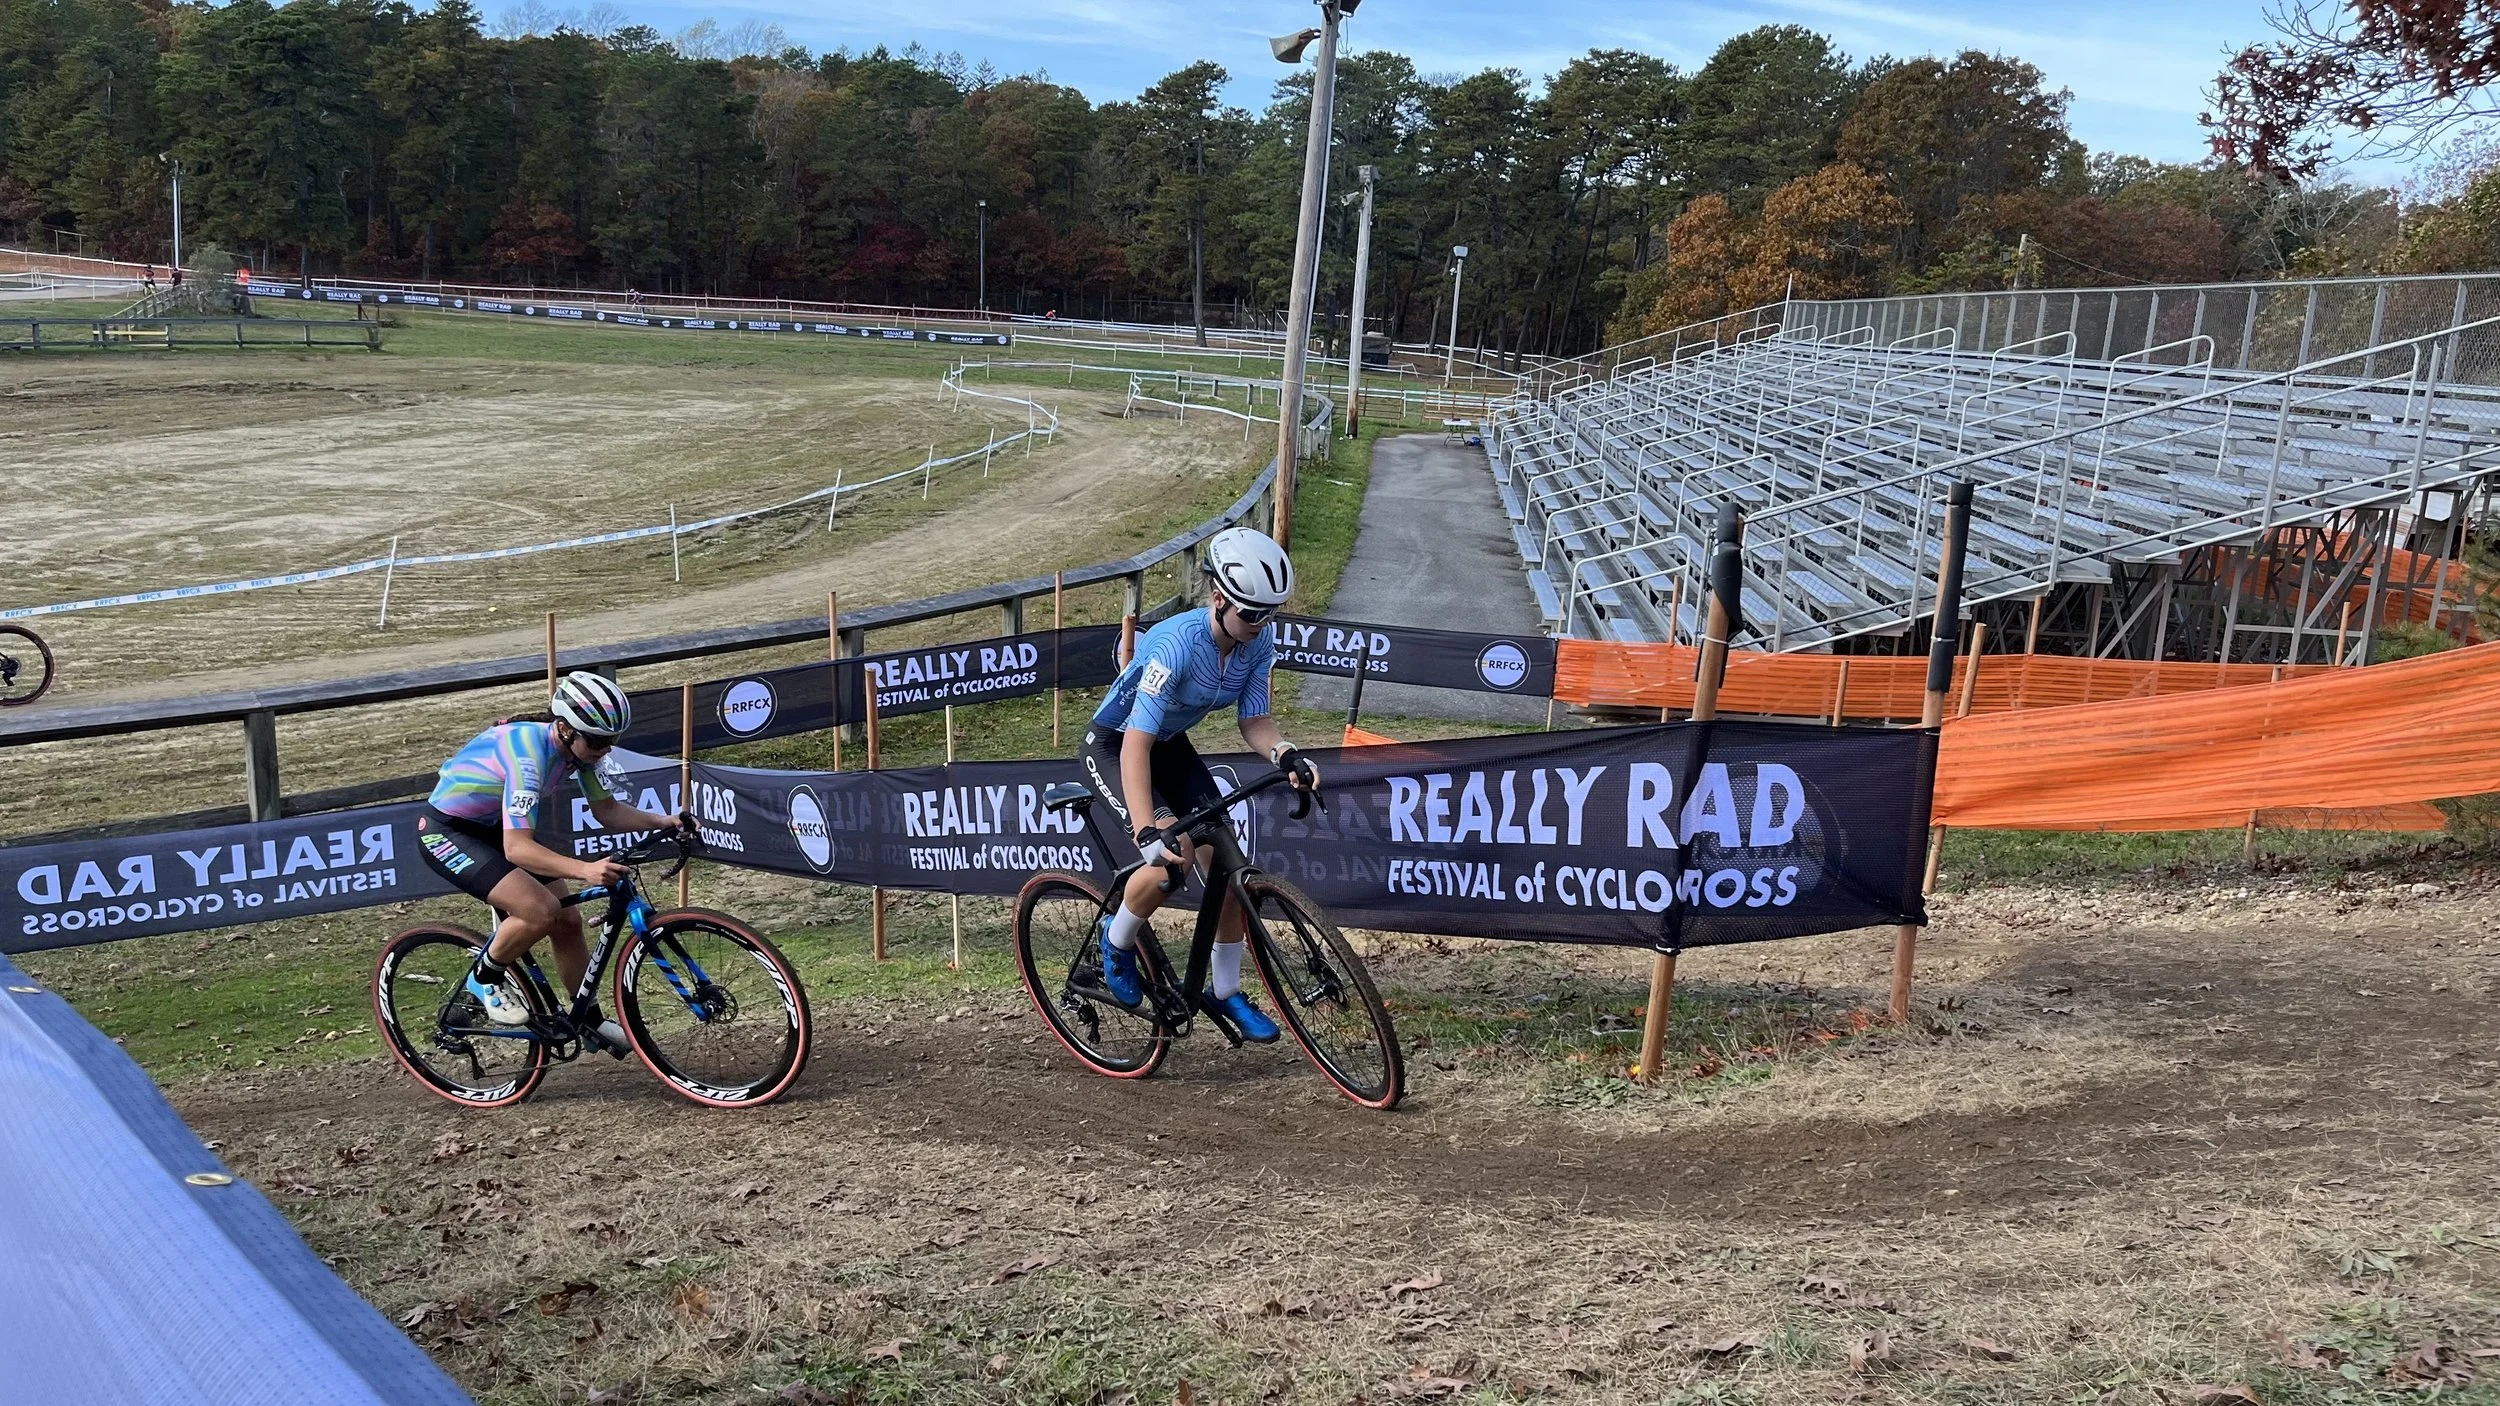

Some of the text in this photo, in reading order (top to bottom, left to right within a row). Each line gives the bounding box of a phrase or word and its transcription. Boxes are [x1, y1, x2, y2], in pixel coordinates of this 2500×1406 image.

[136, 592, 163, 601] RRFCX
[176, 587, 201, 596] RRFCX
[214, 583, 238, 592] RRFCX
[250, 578, 272, 587] RRFCX
[4, 608, 33, 618] RRFCX
[50, 603, 78, 612] RRFCX
[94, 597, 121, 606] RRFCX
[1271, 621, 1391, 656] LLY RAD
[864, 642, 1038, 689] REALLY RAD
[1277, 649, 1291, 661] of
[1488, 659, 1524, 672] RRFCX
[876, 671, 1037, 708] ESTIVAL of CYCLOCROSS
[1144, 665, 1165, 688] 251
[731, 698, 771, 715] RRFCX
[1085, 755, 1128, 820] ORBEA
[571, 780, 700, 832] RALY
[702, 783, 737, 825] RAD
[903, 785, 1008, 838] REALLY
[1385, 762, 1806, 850] REALLY RAD
[574, 826, 745, 856] FESTIV CLOCROSS
[798, 822, 828, 839] RRFCX
[420, 833, 475, 875] BEAR CX
[909, 846, 970, 871] FESTIVAL
[972, 843, 987, 870] of
[990, 846, 1094, 873] CYCLOCROSS
[1387, 859, 1506, 901] FESTIVAL
[1514, 861, 1546, 903] of
[576, 921, 614, 999] TREK
[379, 951, 395, 1025] ZIPP
[749, 950, 799, 1030] ZIPP
[451, 1079, 517, 1101] ZIPP
[670, 1074, 751, 1101] ZIPP
